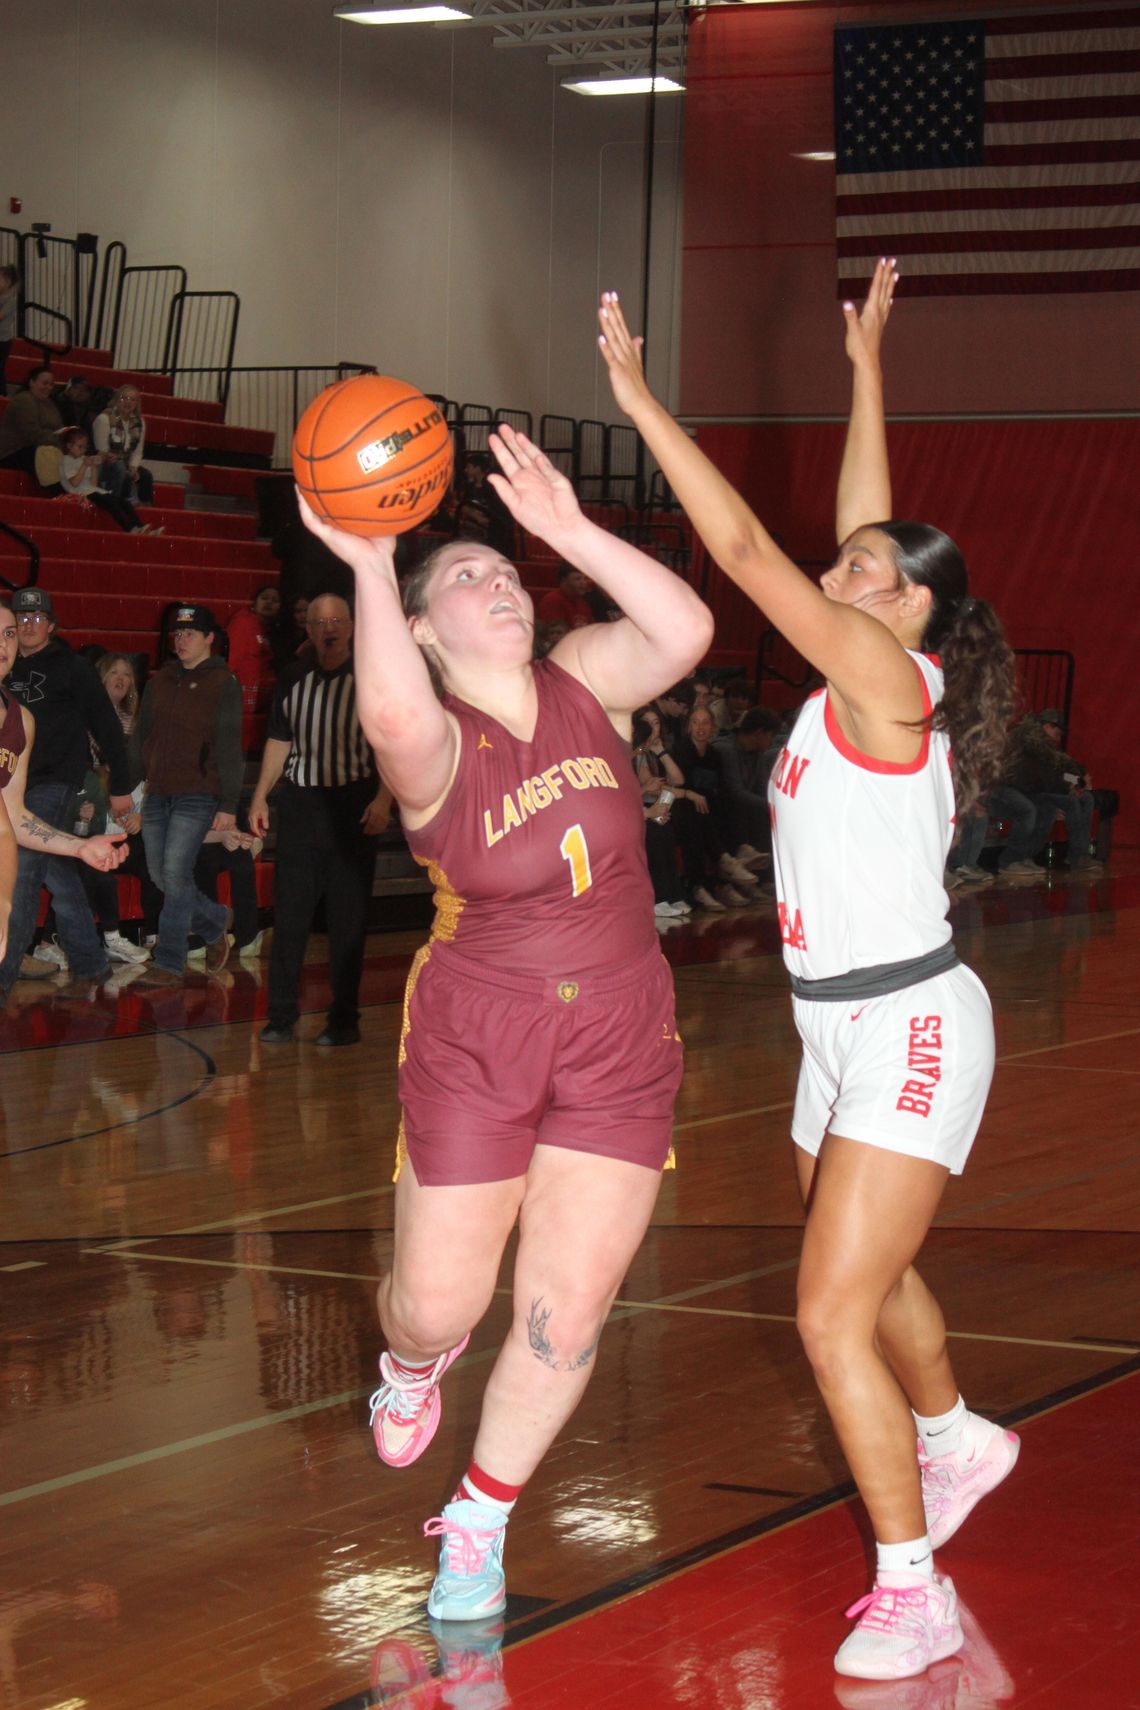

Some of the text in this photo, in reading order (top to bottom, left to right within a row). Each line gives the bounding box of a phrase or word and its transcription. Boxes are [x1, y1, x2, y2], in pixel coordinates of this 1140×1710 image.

[484, 757, 619, 848] LANGFORD
[560, 823, 592, 898] 1
[896, 1015, 942, 1118] BRAVES
